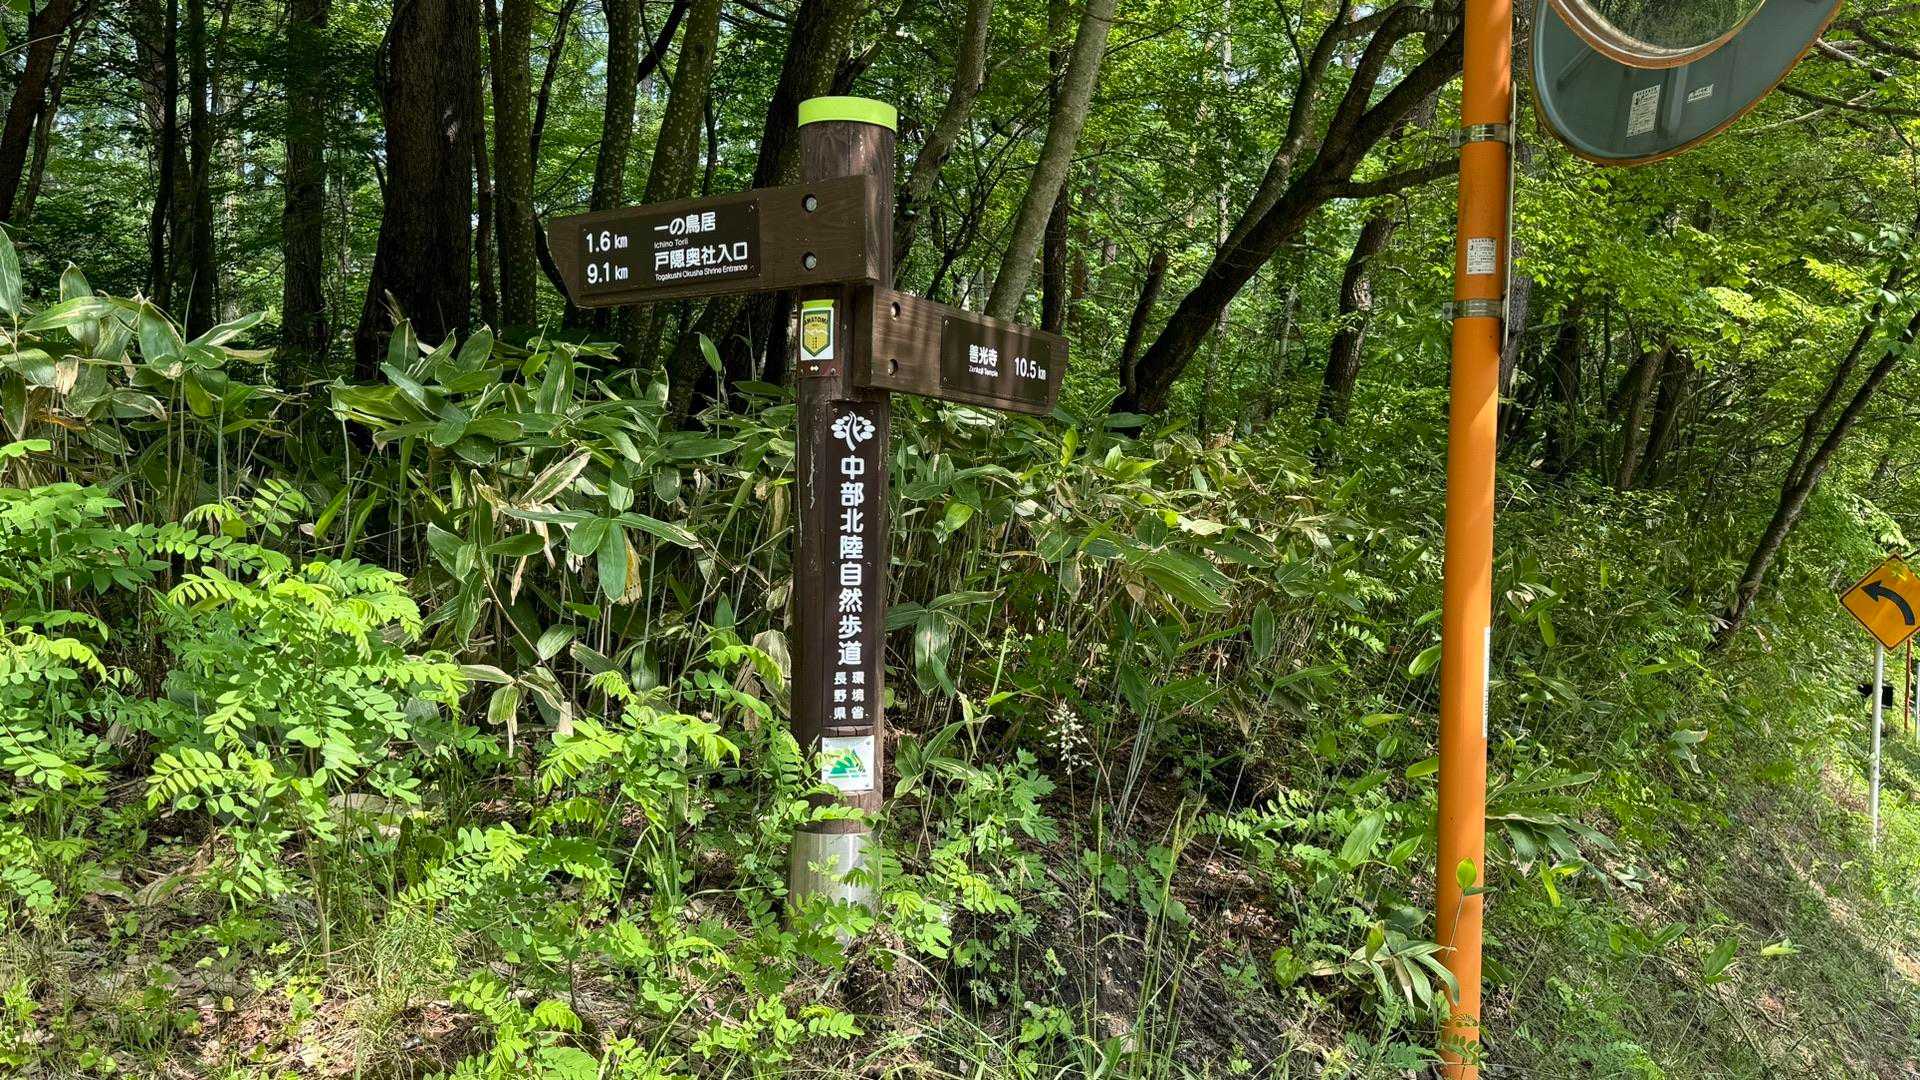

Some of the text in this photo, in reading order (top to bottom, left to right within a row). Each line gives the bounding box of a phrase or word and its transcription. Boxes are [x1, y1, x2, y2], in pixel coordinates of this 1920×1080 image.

[654, 211, 716, 235] 一の鳥居
[586, 230, 628, 253] 1.6 km
[675, 238, 689, 247] Torii
[654, 241, 748, 271] 戸隠奥社入口
[587, 261, 629, 284] 9.1 km
[655, 265, 747, 282] Togakushi Okusha Shrine Entrance
[969, 344, 998, 367] 善光寺
[1014, 357, 1047, 380] 10.5 km
[838, 454, 865, 666] 中部北陸自然歩道
[833, 671, 847, 720] 長野県
[851, 671, 865, 720] 環境省
